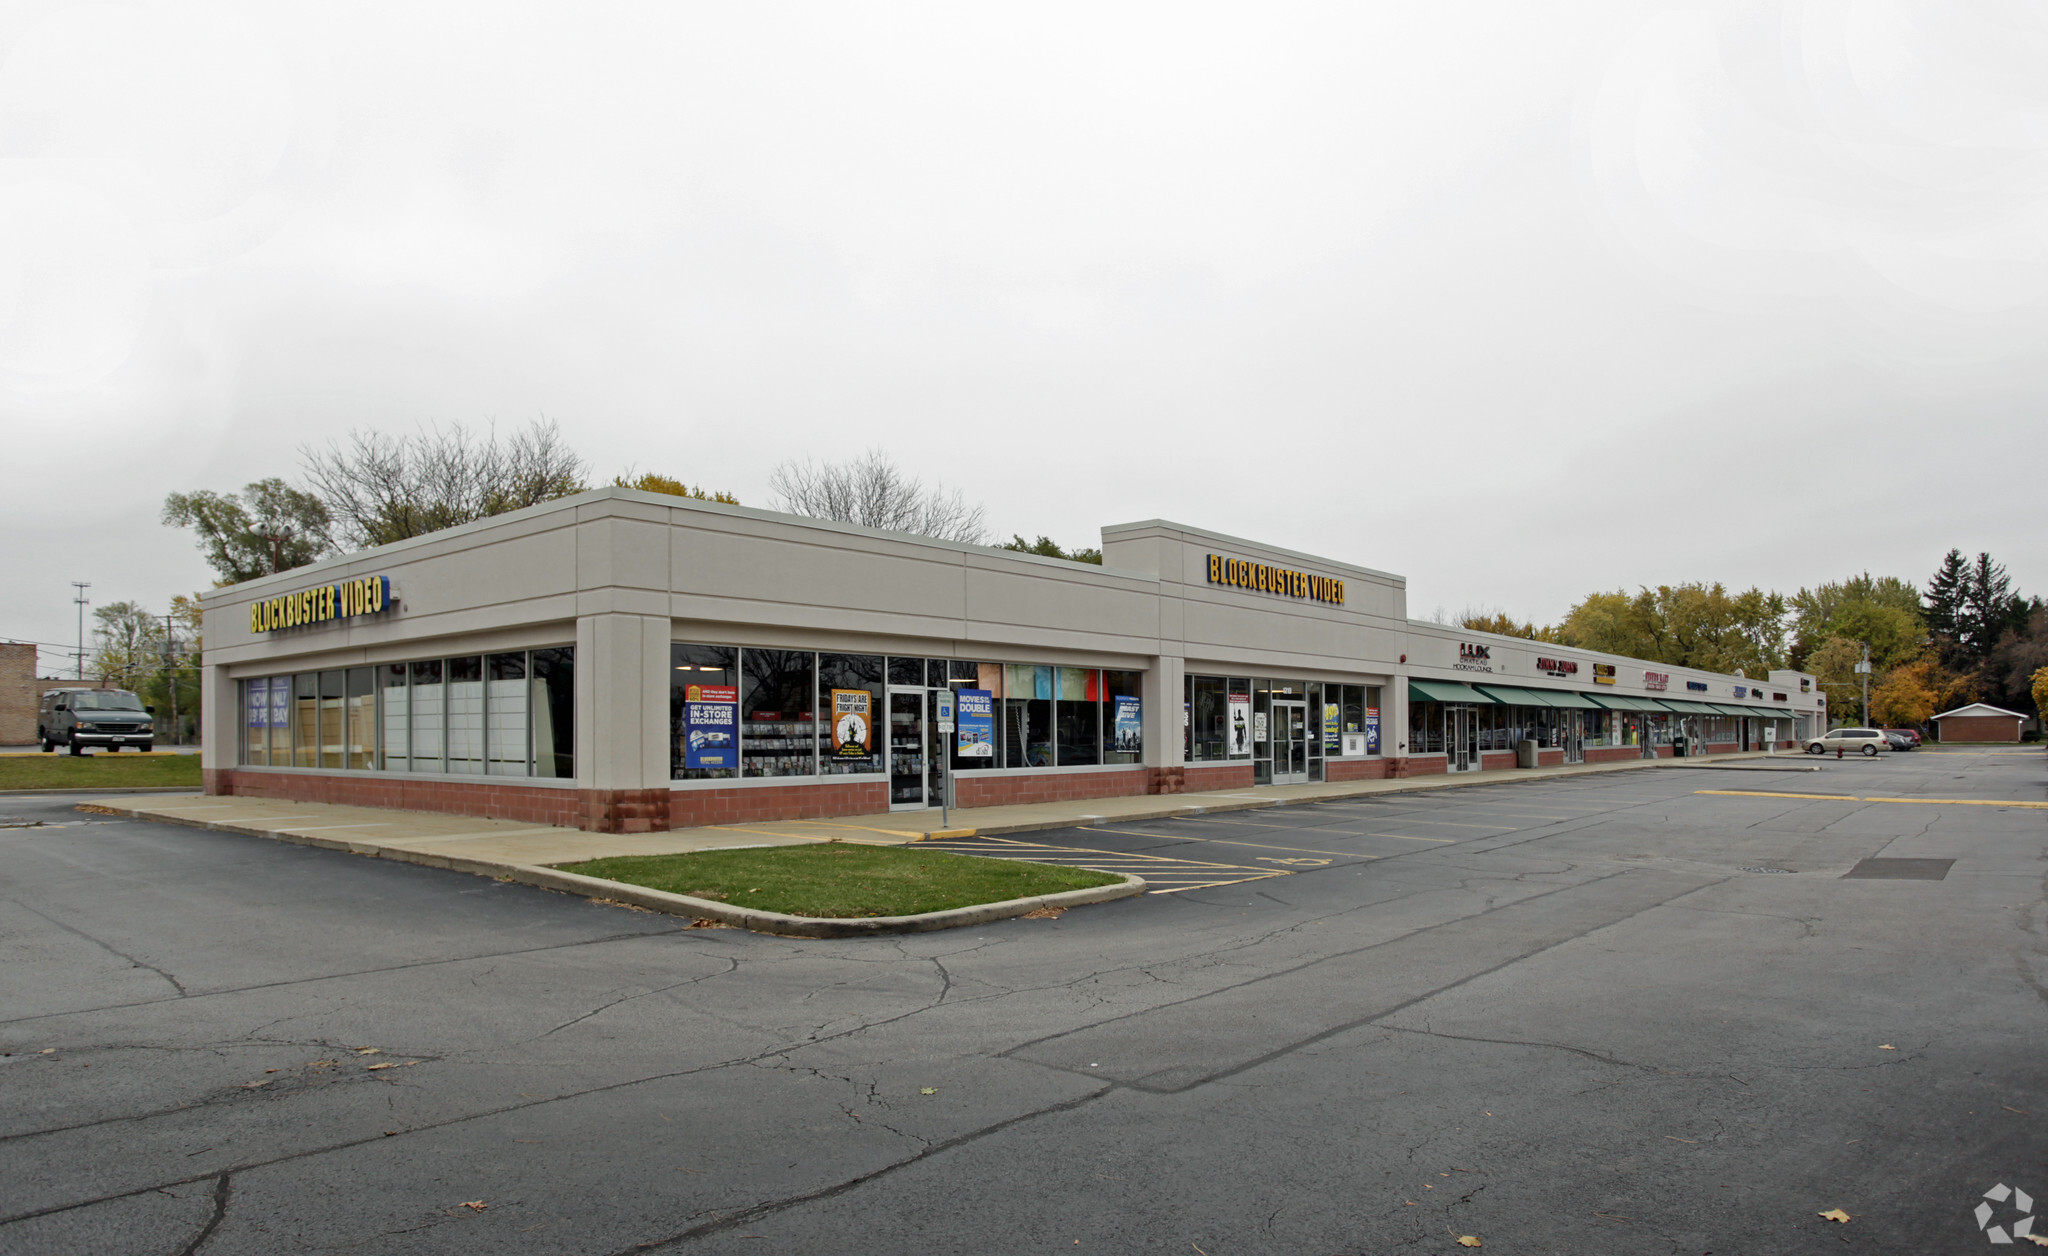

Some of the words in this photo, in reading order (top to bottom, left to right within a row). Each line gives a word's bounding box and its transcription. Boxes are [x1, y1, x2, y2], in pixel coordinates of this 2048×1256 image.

[1207, 554, 1308, 598] BLOCKBUSTER
[1308, 575, 1345, 604] VIDEO
[251, 584, 336, 633] BLOCKBUSTER
[339, 575, 383, 618] VIDEO
[1460, 642, 1490, 659] LUX
[836, 694, 857, 703] FRIDAYS
[858, 694, 868, 703] ARE
[836, 703, 852, 713] FRIGHT
[960, 703, 990, 713] DOUBLE
